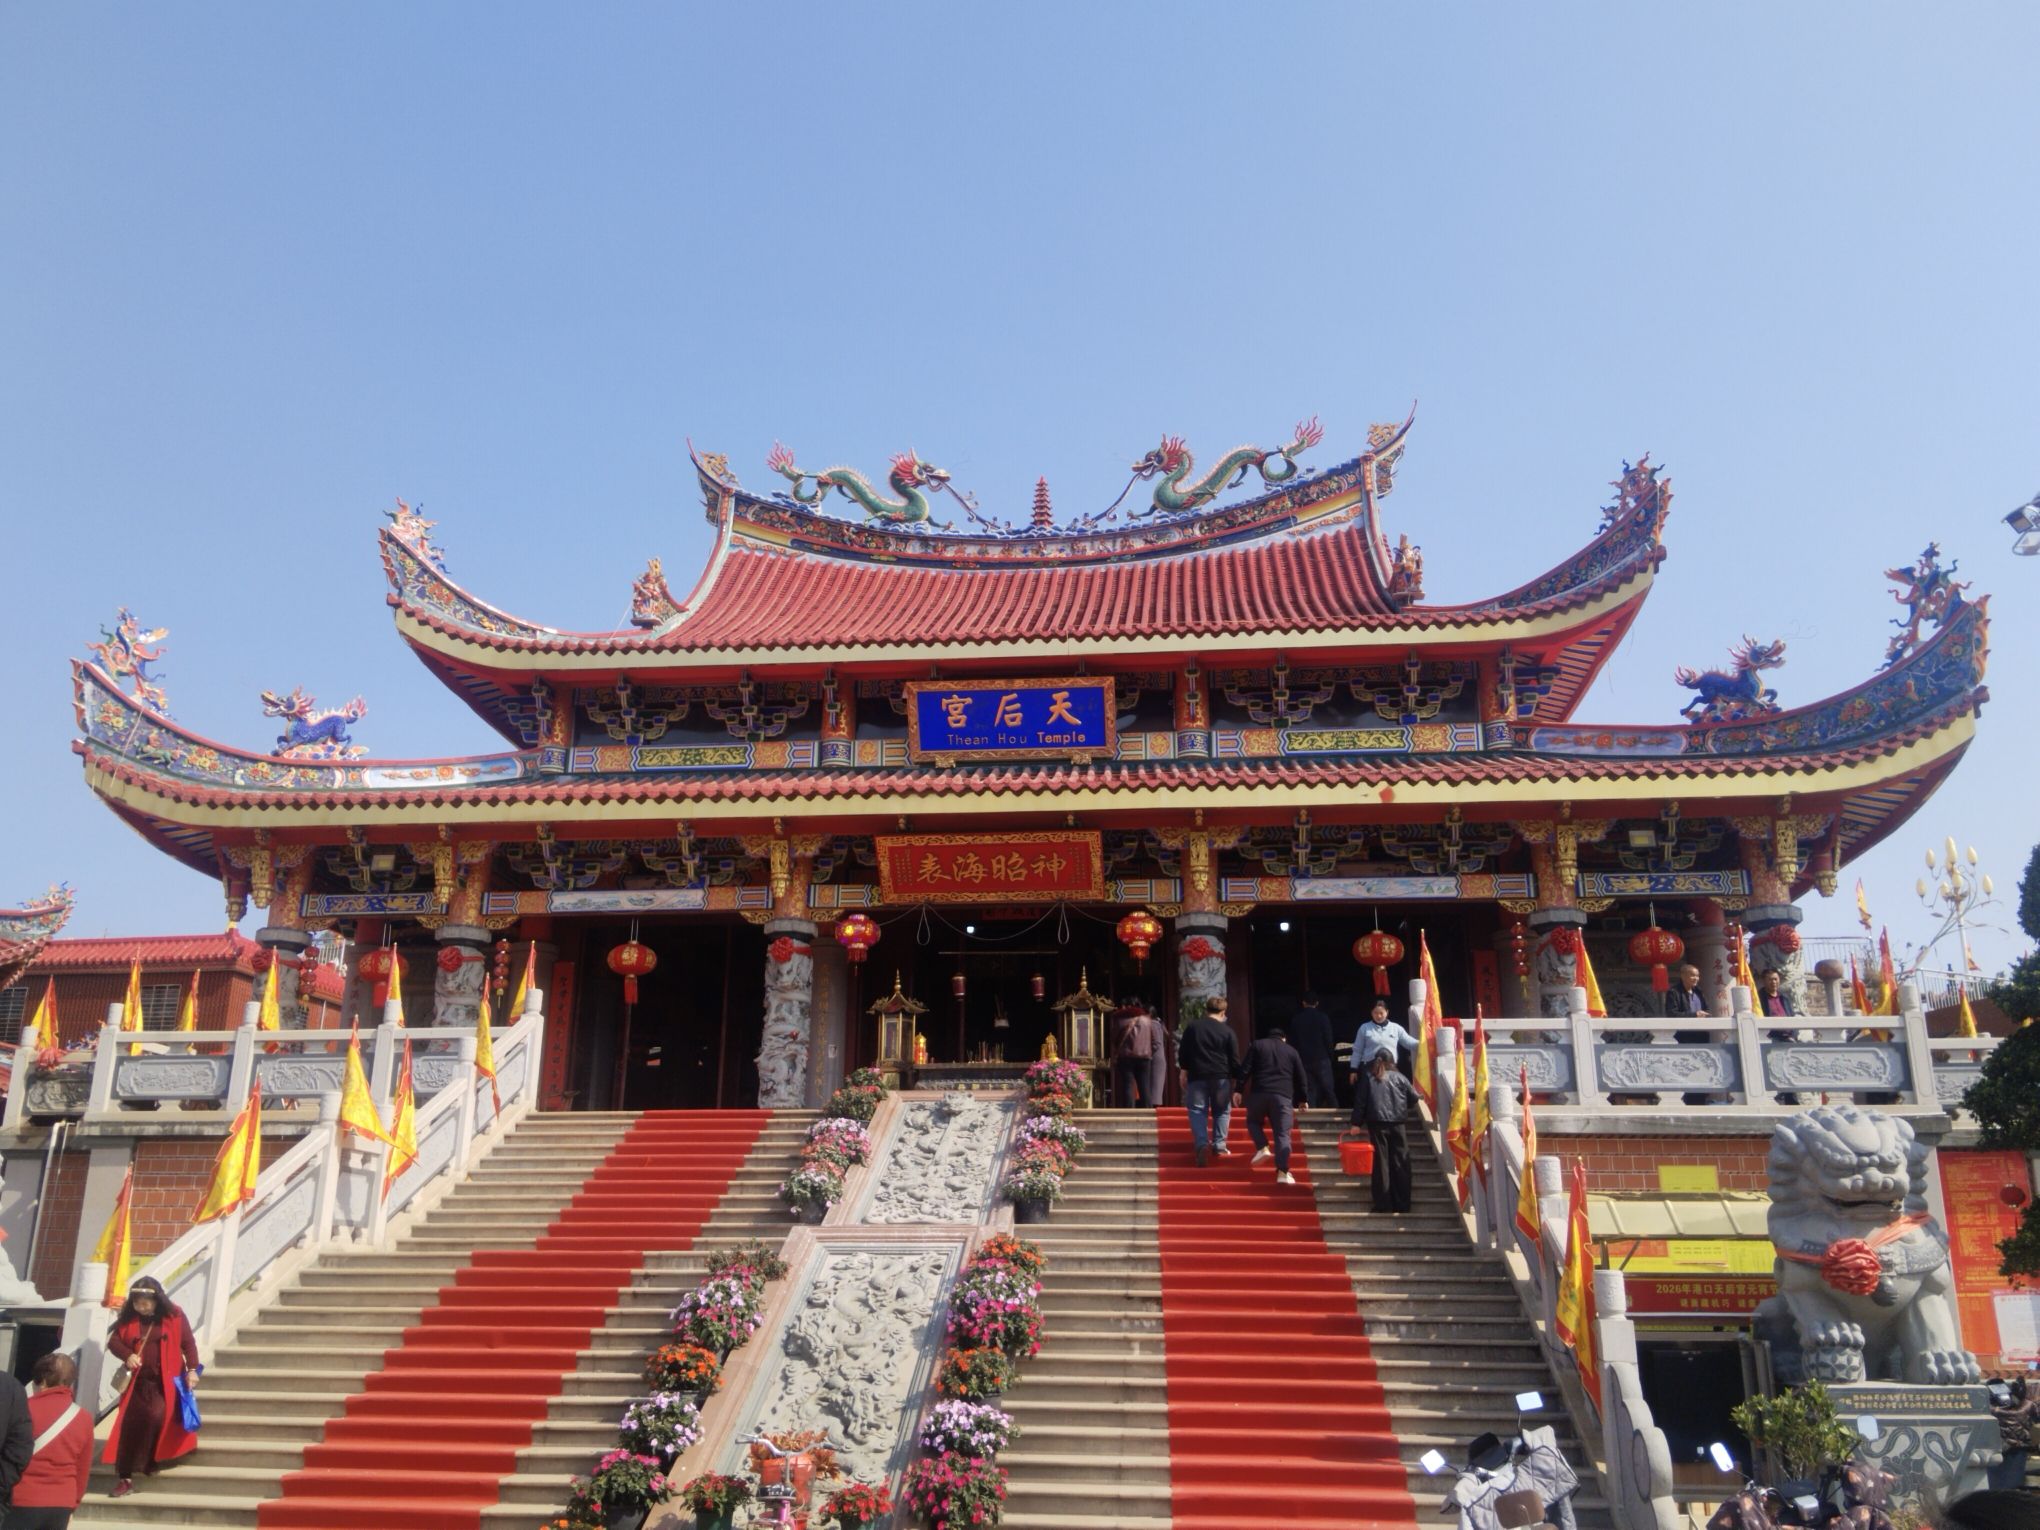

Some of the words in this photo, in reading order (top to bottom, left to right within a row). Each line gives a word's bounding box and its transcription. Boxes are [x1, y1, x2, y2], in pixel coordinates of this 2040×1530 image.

[947, 734, 989, 746] Thean
[998, 733, 1028, 745] Hou
[1037, 731, 1086, 745] Temple
